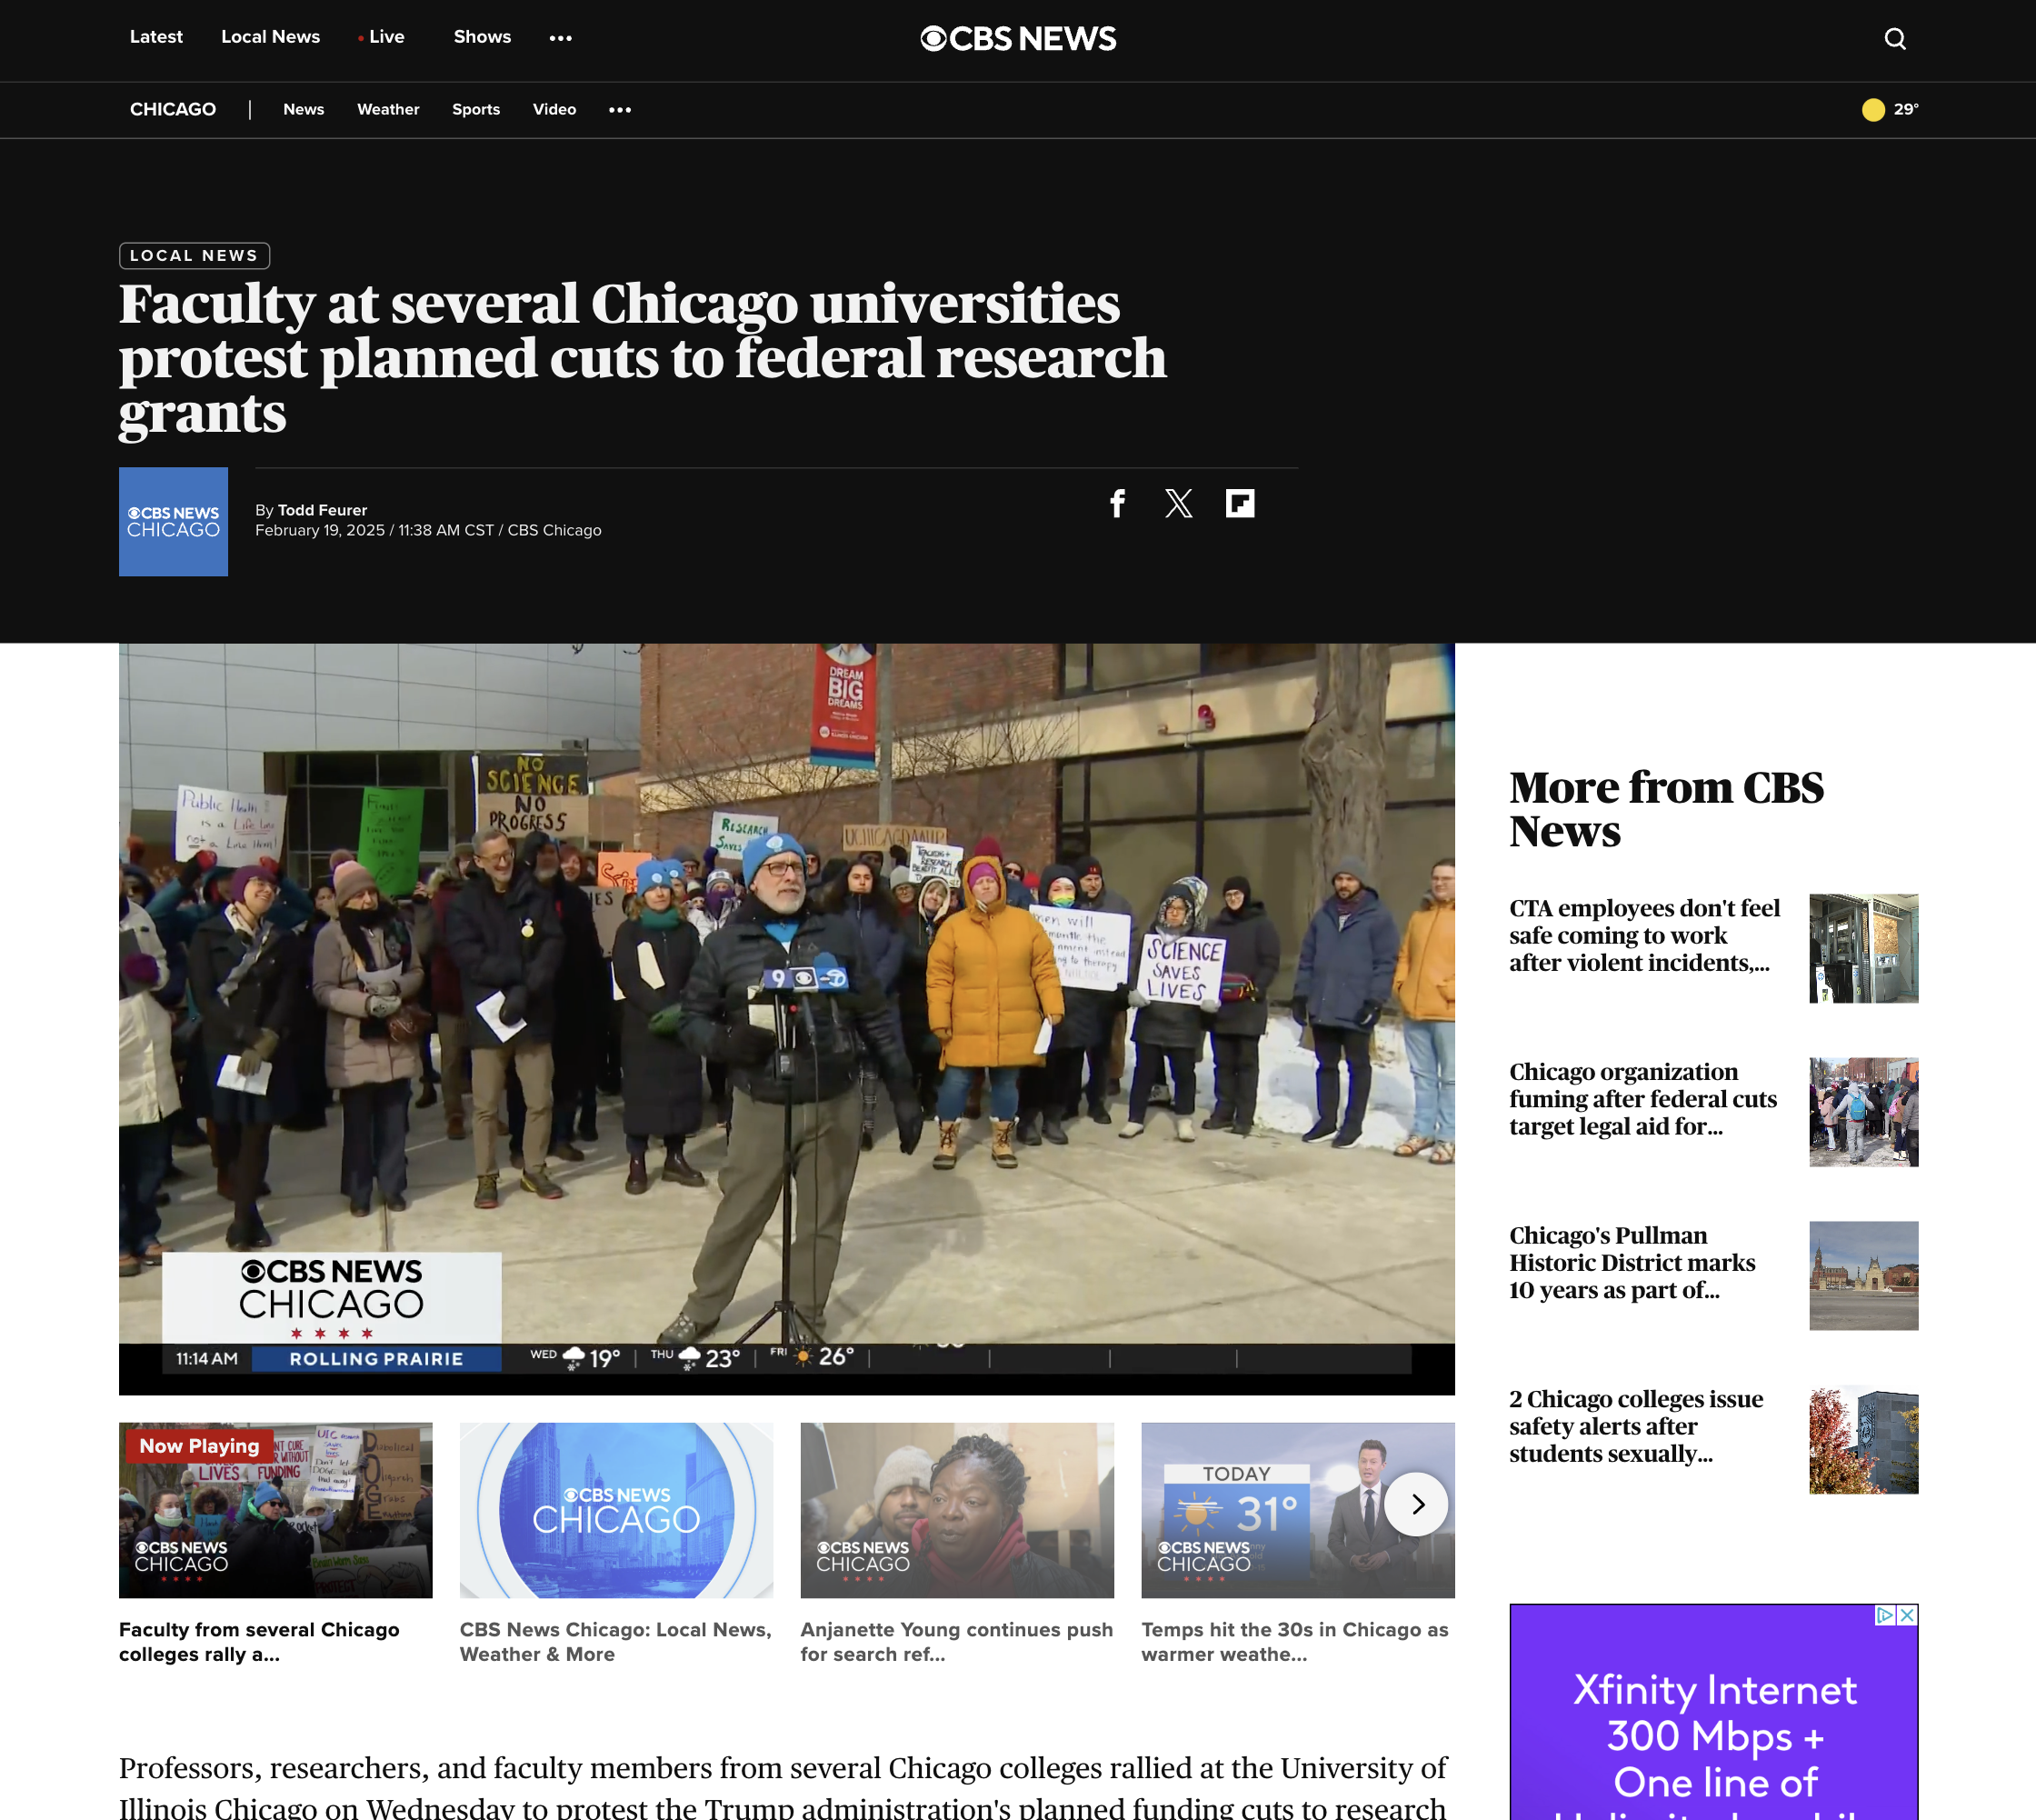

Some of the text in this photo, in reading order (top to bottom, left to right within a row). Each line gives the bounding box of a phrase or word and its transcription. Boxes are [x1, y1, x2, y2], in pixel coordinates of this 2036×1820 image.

[131, 29, 511, 43] Latest Local News Live Shows
[950, 26, 1116, 51] CBS NEWS
[131, 103, 215, 115] CHICAGO
[284, 103, 576, 117] News Weather Sports Video
[131, 250, 256, 261] LOCAL NEWS
[120, 281, 1120, 335] Faculty at several Chicago universities
[119, 335, 1167, 389] protest planned cuts to federal research
[118, 395, 286, 444] grants
[142, 507, 219, 519] CBS NEWS
[256, 505, 367, 518] By Todd Feurer
[127, 523, 220, 536] CHICAGO
[256, 525, 602, 539] February 19, 2025 / 11:38 AM CST / CBS Chicago
[829, 665, 864, 682] DREAM
[828, 676, 863, 701] BIG
[827, 697, 863, 711] DREAMS
[517, 755, 544, 773] NO
[486, 769, 581, 795] SCIENCE
[1510, 769, 1824, 804] More from CBS
[182, 789, 224, 812] Public
[514, 795, 546, 814] NO
[234, 818, 255, 830] Life
[489, 811, 567, 833] PROGRESS
[186, 835, 205, 844] not
[1510, 816, 1621, 847] News
[1067, 915, 1093, 928] will
[1087, 933, 1106, 945] the
[1093, 948, 1126, 957] instead
[1147, 938, 1223, 962] SCIENCE
[1083, 956, 1117, 973] therapy
[1153, 962, 1201, 980] SAVES
[772, 969, 785, 988] 9
[1147, 979, 1206, 1001] LIVES
[1510, 1390, 1763, 1411] 2 Chicago colleges issue
[317, 1430, 338, 1439] UIC
[1511, 1416, 1698, 1438] safety alerts after
[287, 1439, 304, 1452] CURE
[281, 1450, 309, 1463] WITHOUT
[1511, 1445, 1712, 1466] students sexually...
[199, 1466, 240, 1481] LIVES
[257, 1465, 301, 1480] FUNDING
[312, 1555, 333, 1569] Brain
[461, 1622, 771, 1640] CBS News Chicago: Local News,
[460, 1646, 614, 1661] Weather & More
[1574, 1674, 1857, 1715] Xfinity Internet
[1608, 1720, 1823, 1761] 300 Mbps +
[1615, 1766, 1819, 1797] One line of
